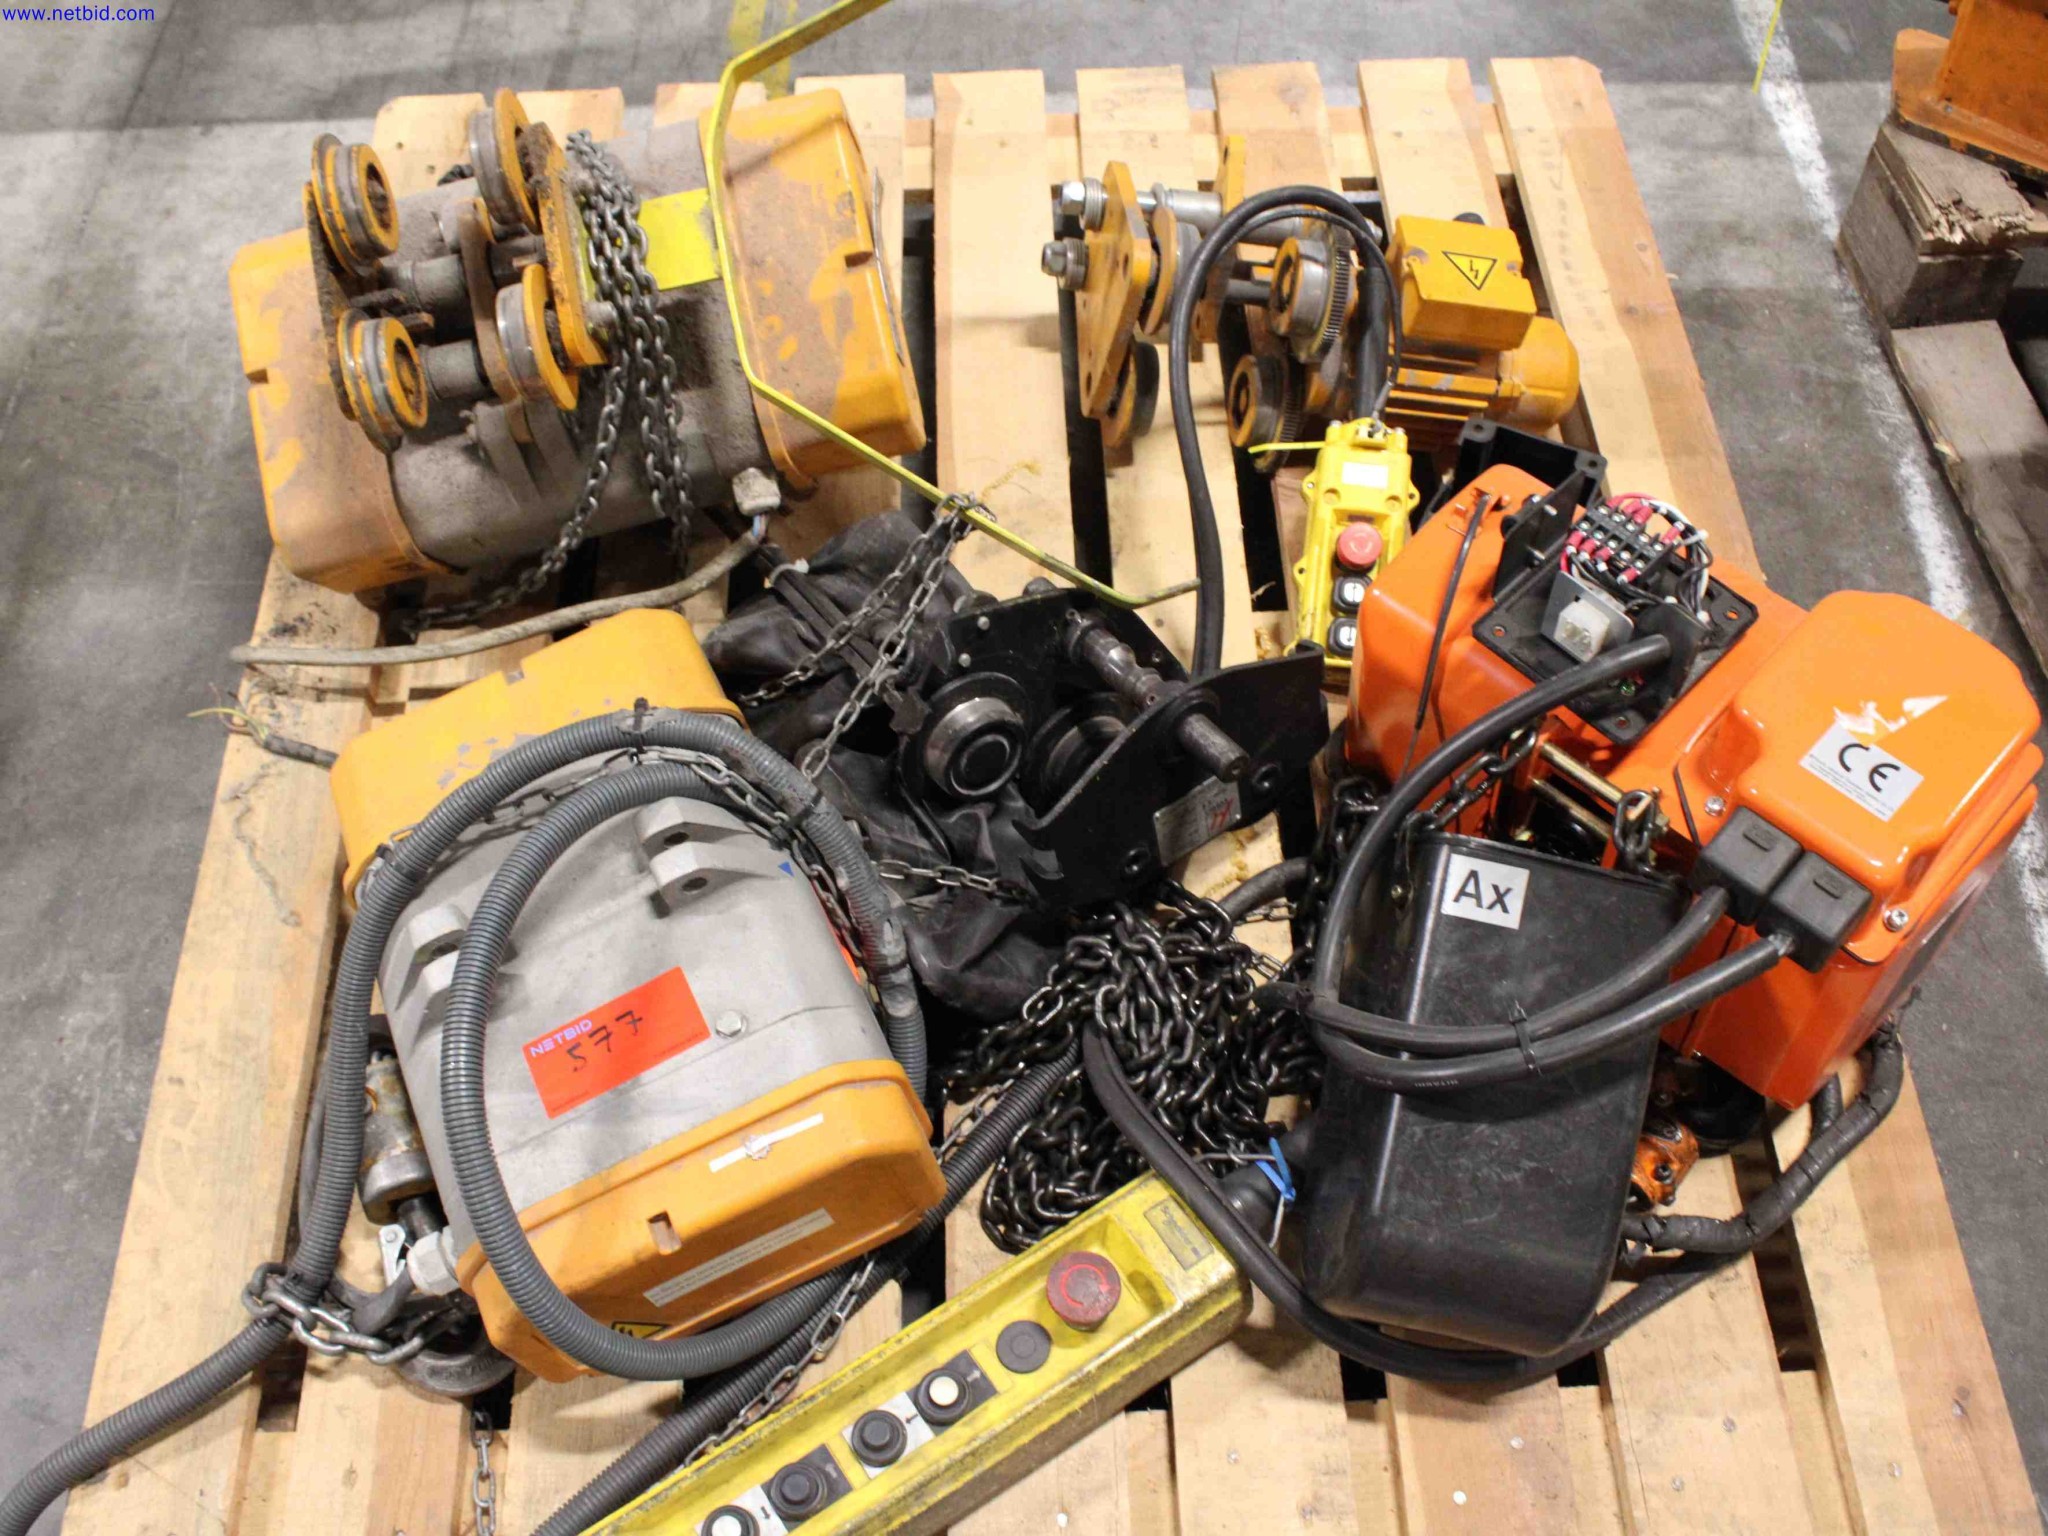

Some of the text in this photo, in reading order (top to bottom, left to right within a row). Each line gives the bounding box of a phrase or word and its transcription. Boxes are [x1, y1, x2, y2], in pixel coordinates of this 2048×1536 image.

[1838, 743, 1900, 792] CE
[1453, 869, 1513, 914] Ax
[529, 1018, 593, 1057] NETBID
[566, 1010, 643, 1072] 577
